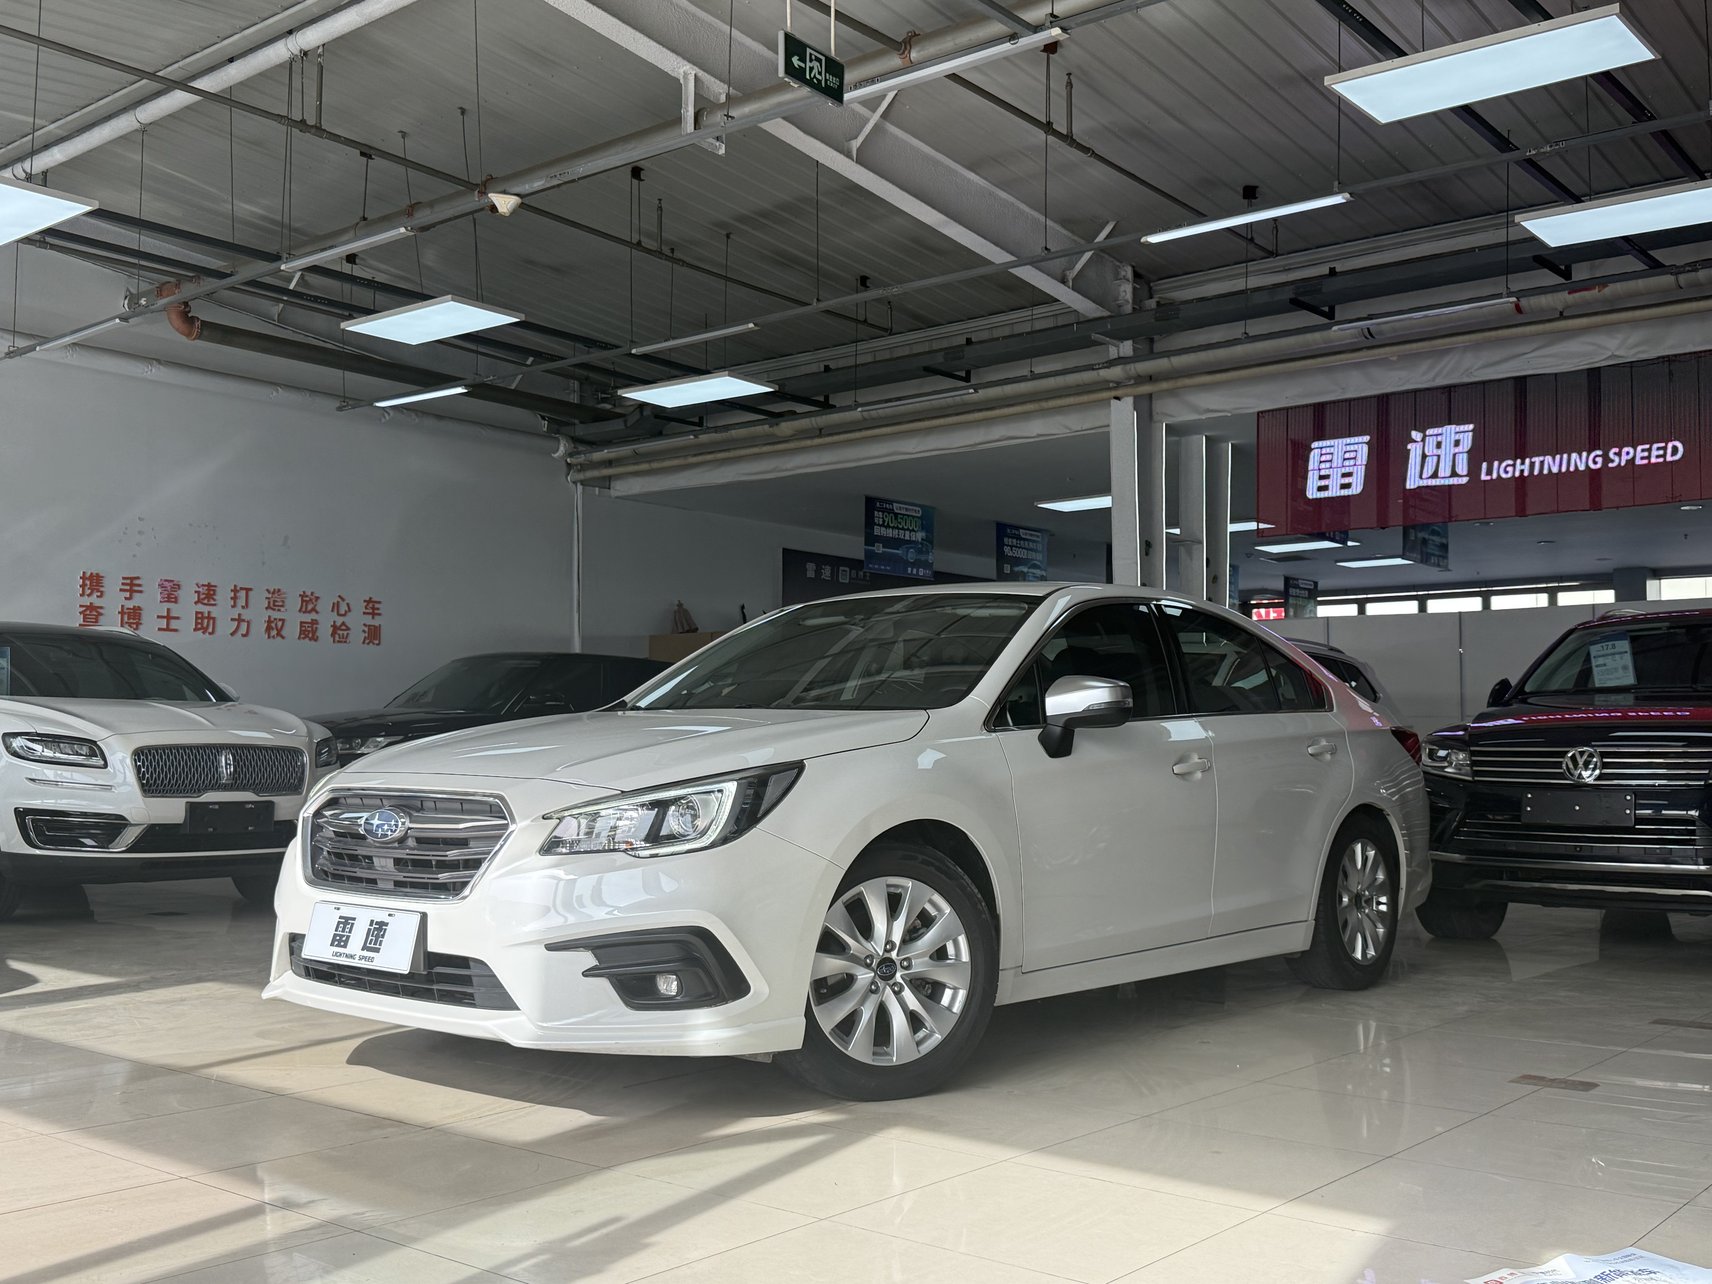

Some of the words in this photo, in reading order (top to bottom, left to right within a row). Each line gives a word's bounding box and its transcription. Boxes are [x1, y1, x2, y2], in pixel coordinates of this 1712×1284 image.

[1305, 423, 1475, 500] 雷速
[1480, 449, 1603, 481] LIGHTNING
[1608, 440, 1684, 468] SPEED
[78, 571, 383, 620] 携手雷速打造放心车
[78, 602, 383, 646] 查博士助力权威检测
[329, 915, 390, 954] 雷速
[331, 950, 357, 961] LIGHTNING
[358, 954, 375, 963] SPEED
